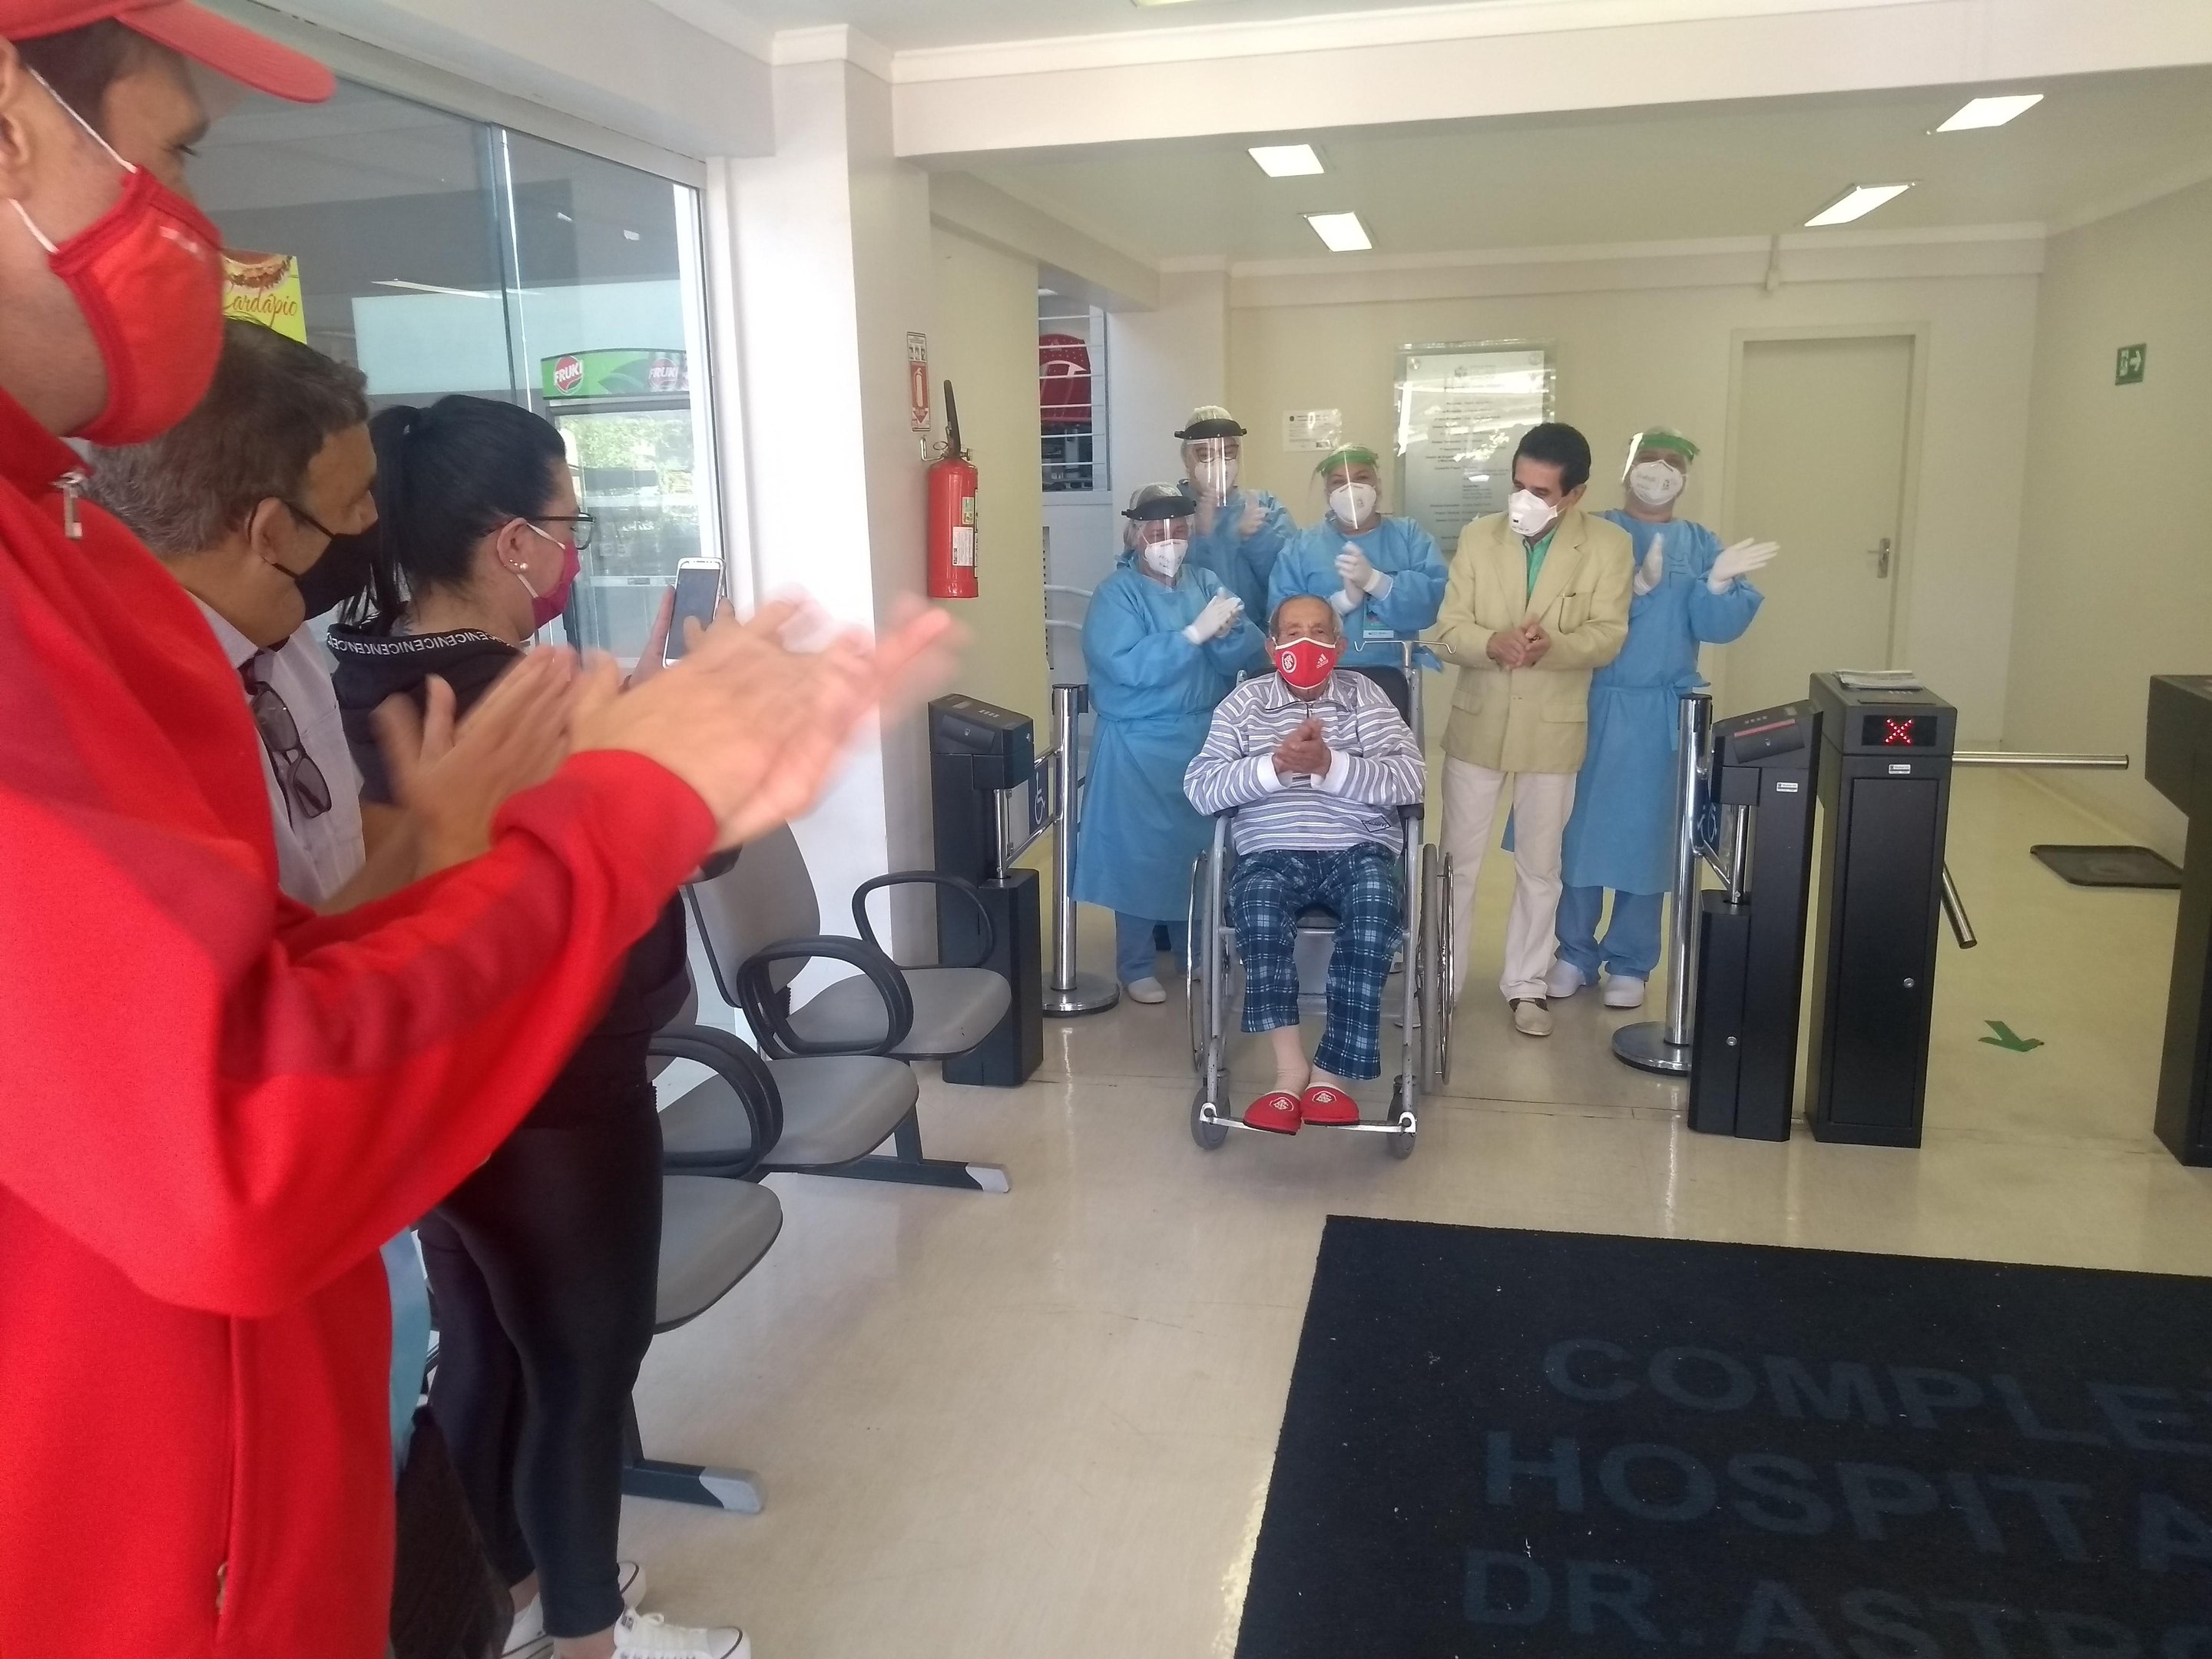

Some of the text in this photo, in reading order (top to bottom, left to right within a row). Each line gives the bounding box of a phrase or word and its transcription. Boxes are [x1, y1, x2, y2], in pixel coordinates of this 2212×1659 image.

[554, 359, 584, 386] FRUKI
[649, 366, 678, 380] FRUKI
[1542, 1338, 2212, 1454] COMPLE
[1462, 1549, 2212, 1659] DR. ASTR
